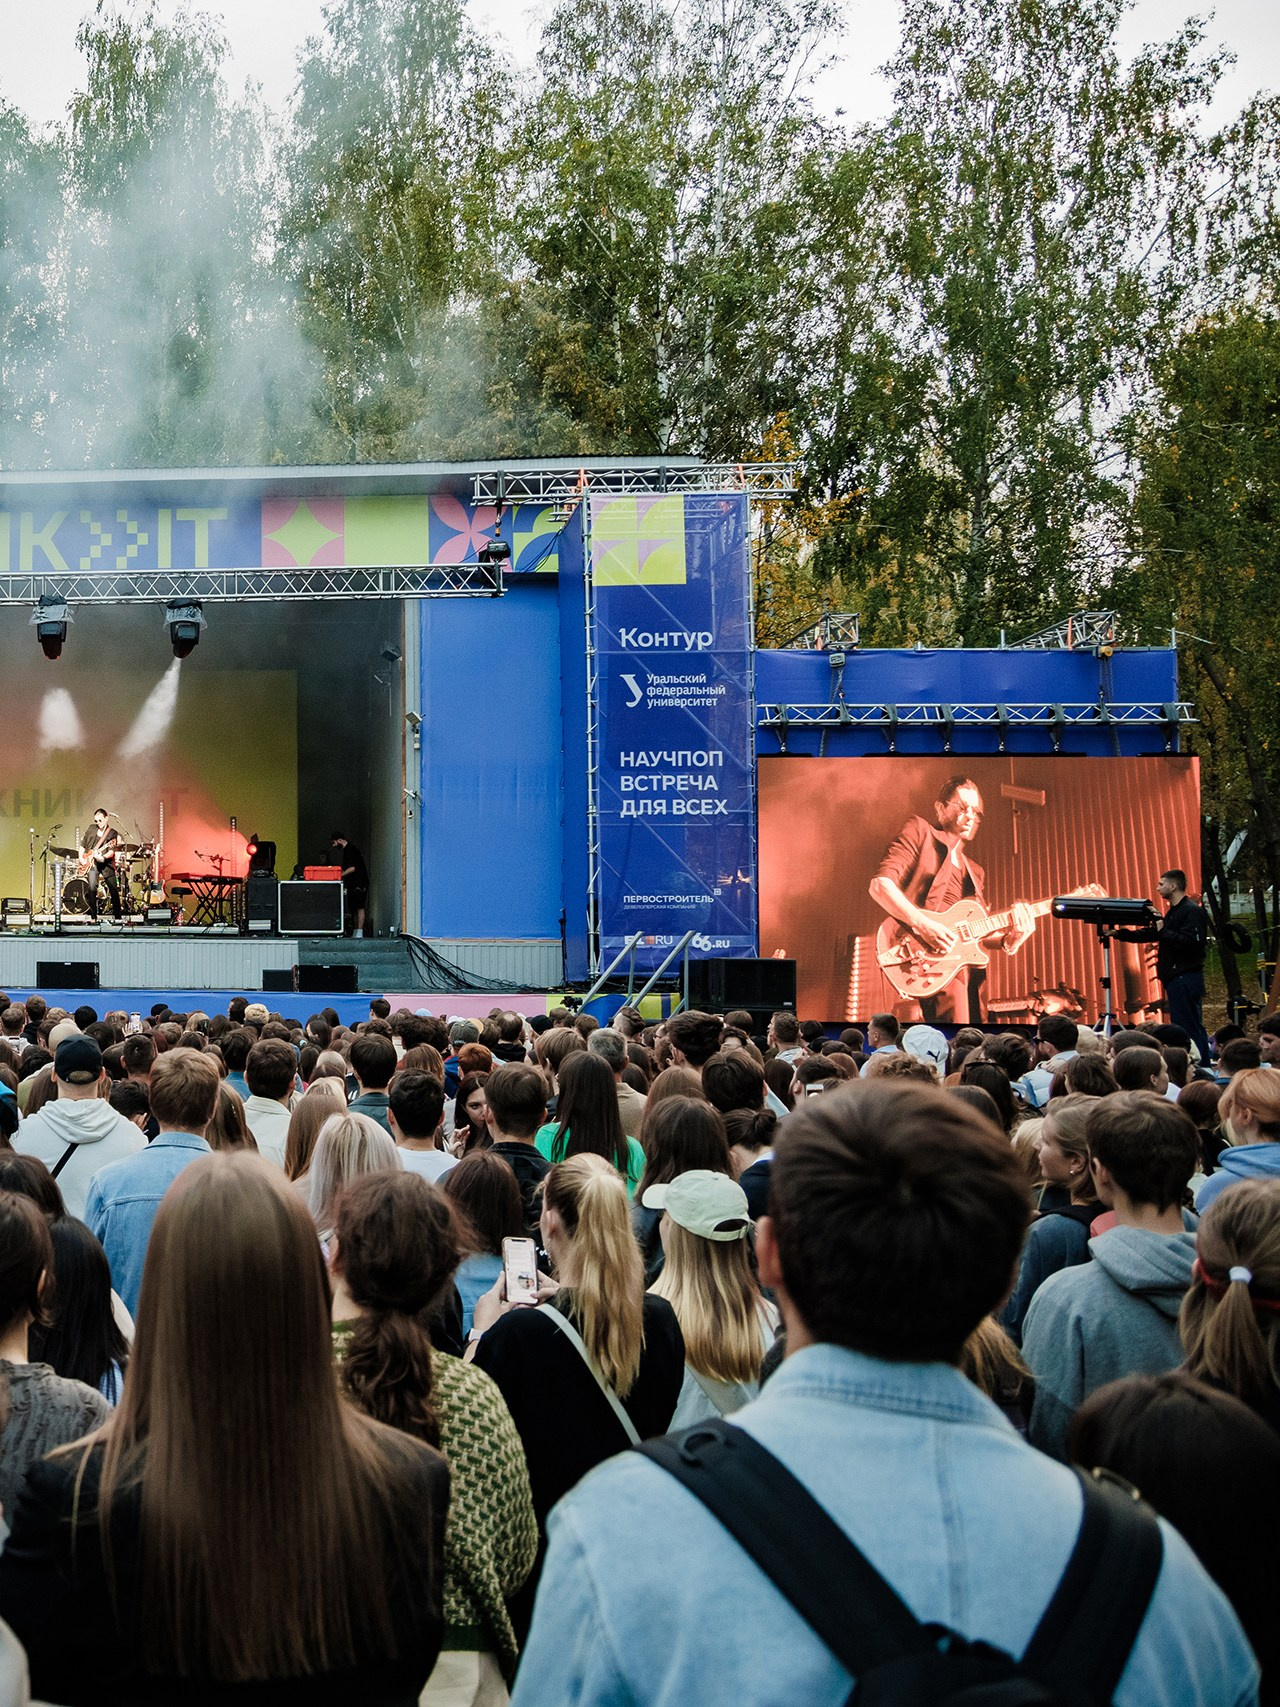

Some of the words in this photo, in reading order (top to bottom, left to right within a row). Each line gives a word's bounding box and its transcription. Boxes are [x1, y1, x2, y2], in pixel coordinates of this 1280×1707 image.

[157, 508, 229, 568] IT
[618, 627, 714, 652] Контур
[646, 673, 706, 685] Уральский
[646, 684, 726, 698] федеральный
[647, 697, 718, 709] университет
[620, 751, 723, 767] НАУЧПОП
[620, 775, 719, 791] ВСТРЕЧА
[620, 799, 667, 818] ДЛЯ
[672, 799, 728, 815] ВСЕХ
[623, 895, 714, 903] ПЕРВОСТРОИТЕЛЬ
[692, 932, 730, 951] 66.RU
